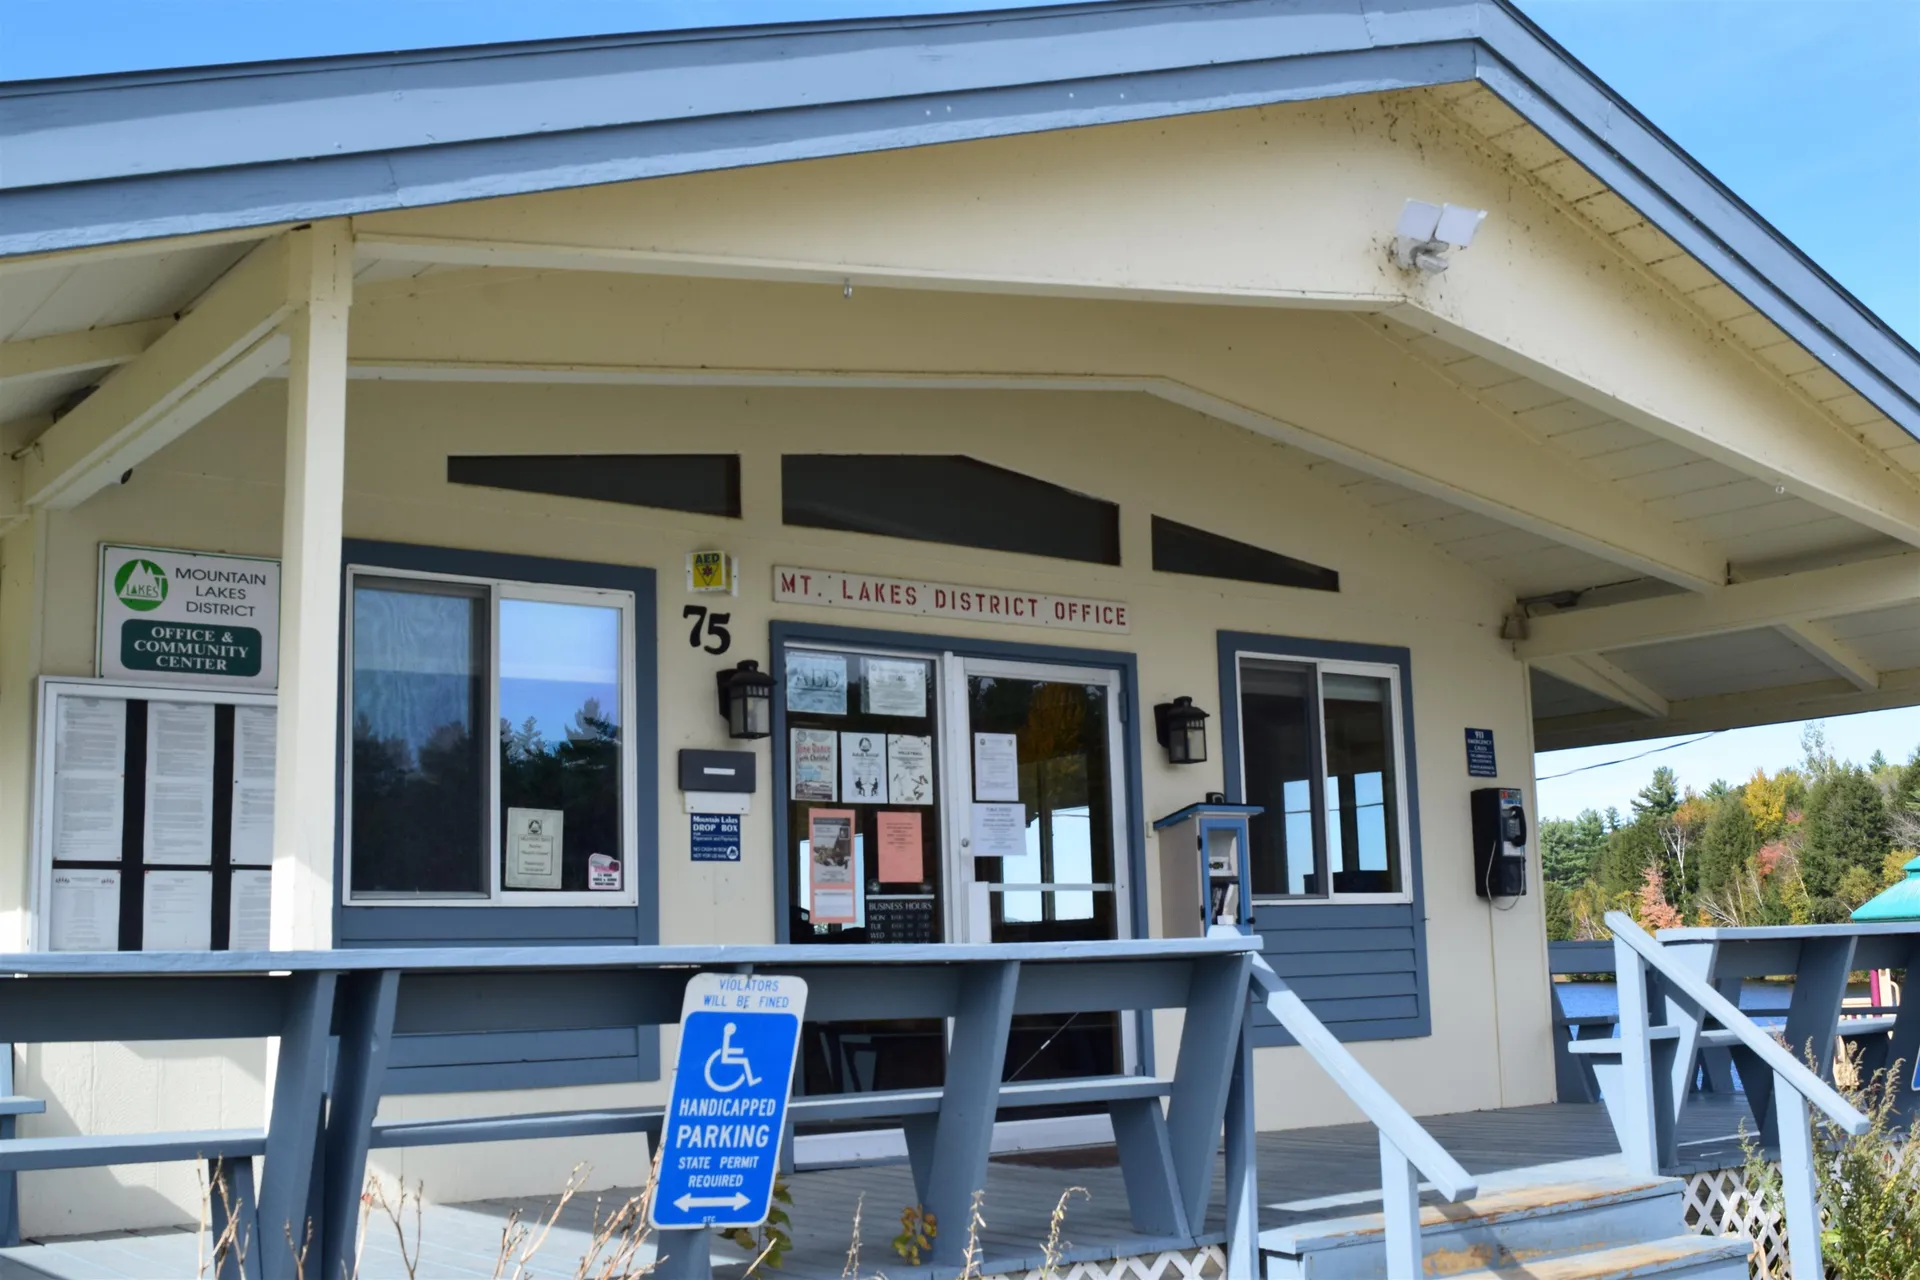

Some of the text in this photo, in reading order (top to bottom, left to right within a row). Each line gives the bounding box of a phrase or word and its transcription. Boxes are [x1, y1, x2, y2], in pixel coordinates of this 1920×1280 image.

[696, 553, 720, 565] AED
[175, 567, 267, 586] MOUNTAIN
[195, 585, 247, 600] LAKES
[781, 572, 1127, 626] MT. LAKES DISTRICT OFFICE
[186, 601, 256, 617] DISTRICT
[151, 626, 234, 643] OFFICE &
[683, 604, 731, 655] 75
[134, 640, 249, 658] COMMUNITY
[156, 655, 228, 670] CENTER
[693, 823, 738, 832] DROP BOX
[869, 902, 932, 911] BUSINESS HOURS
[720, 979, 779, 992] VIOLATORS
[704, 995, 789, 1008] WILL BE FINED
[678, 1098, 776, 1117] HANDICAPPED
[675, 1124, 770, 1149] PARKING
[678, 1156, 759, 1169] STATE PERMIT
[688, 1174, 743, 1188] REQUIRED
